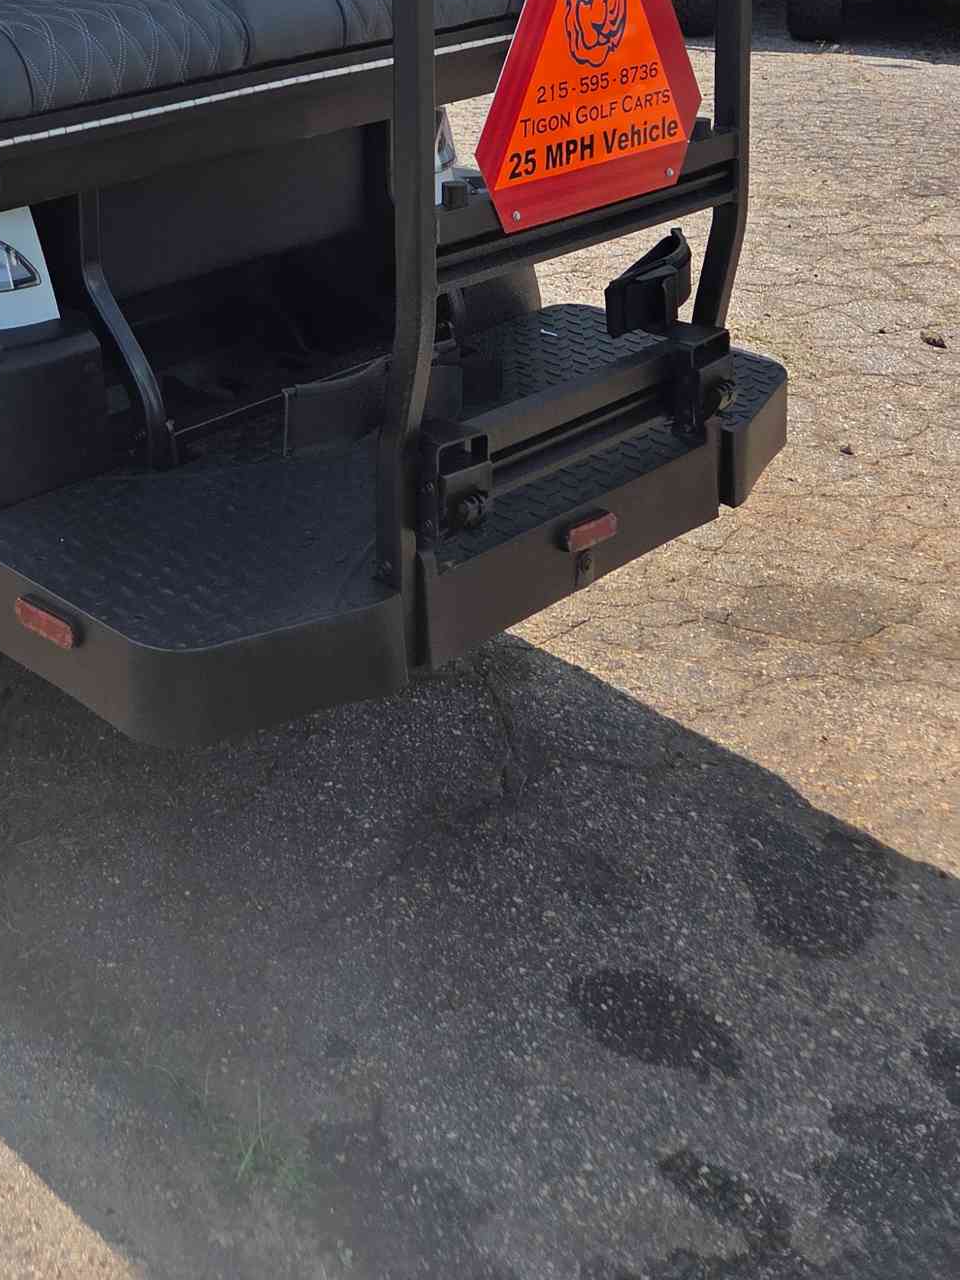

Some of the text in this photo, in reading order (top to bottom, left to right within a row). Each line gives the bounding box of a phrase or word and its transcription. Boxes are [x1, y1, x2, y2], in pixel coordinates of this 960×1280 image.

[520, 88, 671, 138] TIGON GOLF CARTS
[508, 116, 678, 180] 25 MPH Vehicle
